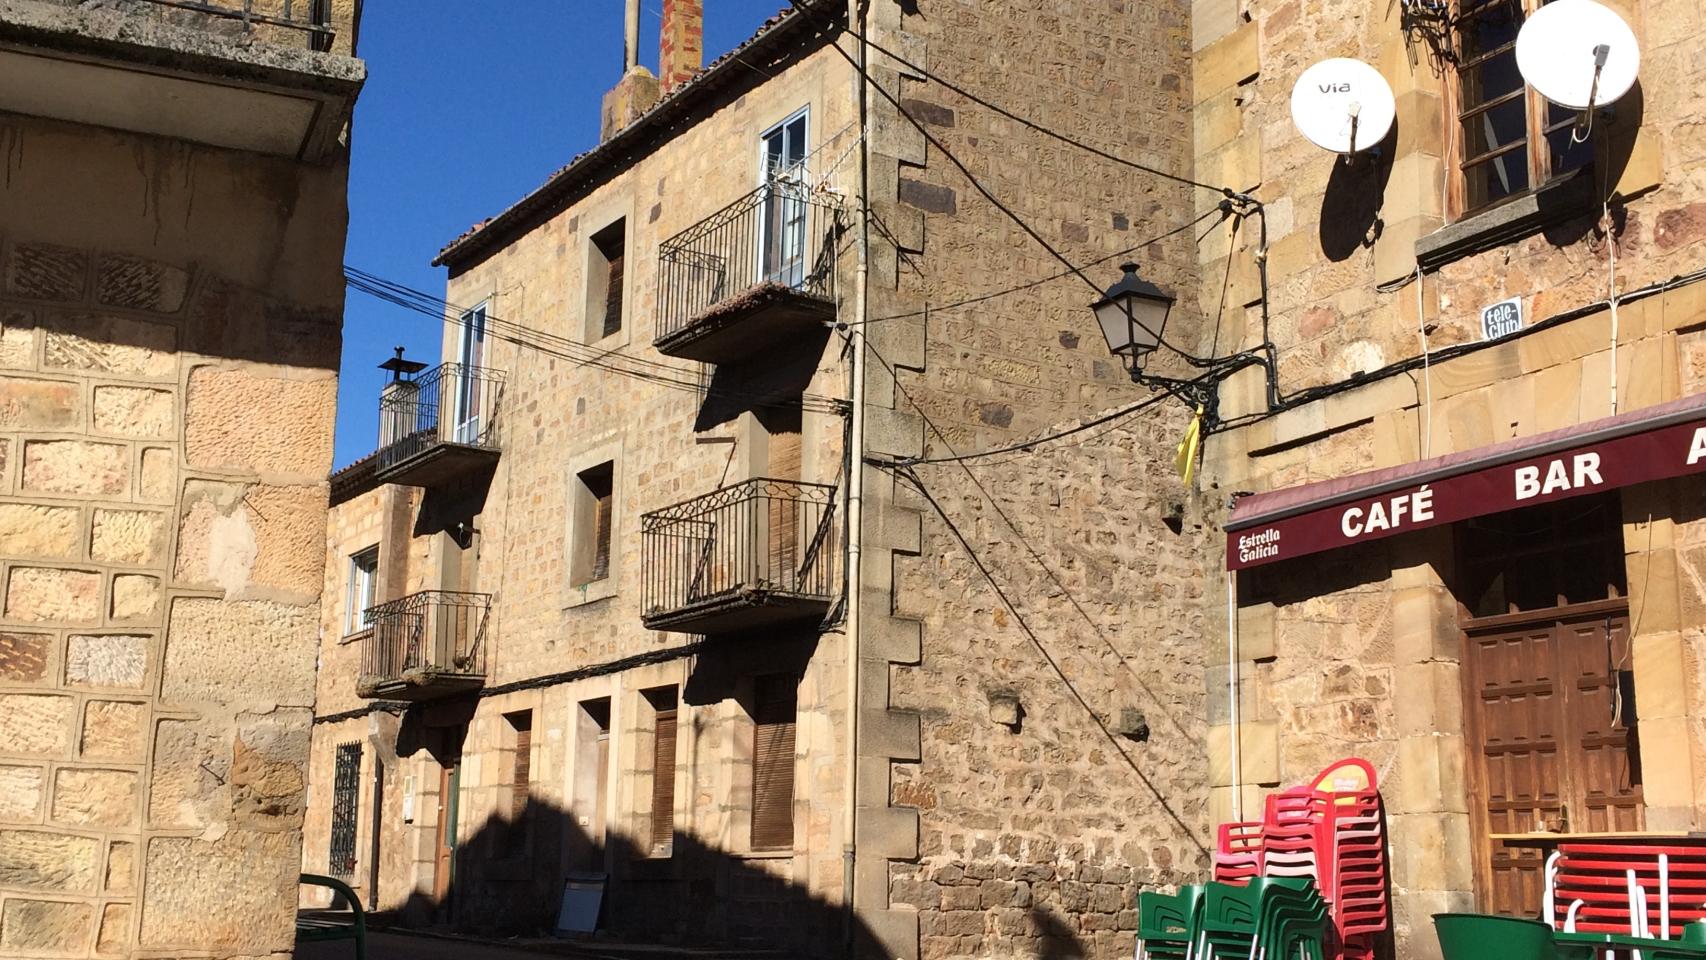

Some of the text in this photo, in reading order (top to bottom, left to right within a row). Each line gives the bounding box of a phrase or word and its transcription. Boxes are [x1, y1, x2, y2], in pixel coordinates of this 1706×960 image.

[1488, 319, 1518, 340] club
[1341, 484, 1435, 538] CAFÉ
[1514, 451, 1604, 501] BAR
[1238, 528, 1281, 550] Estrella
[1239, 543, 1279, 563] Galicia
